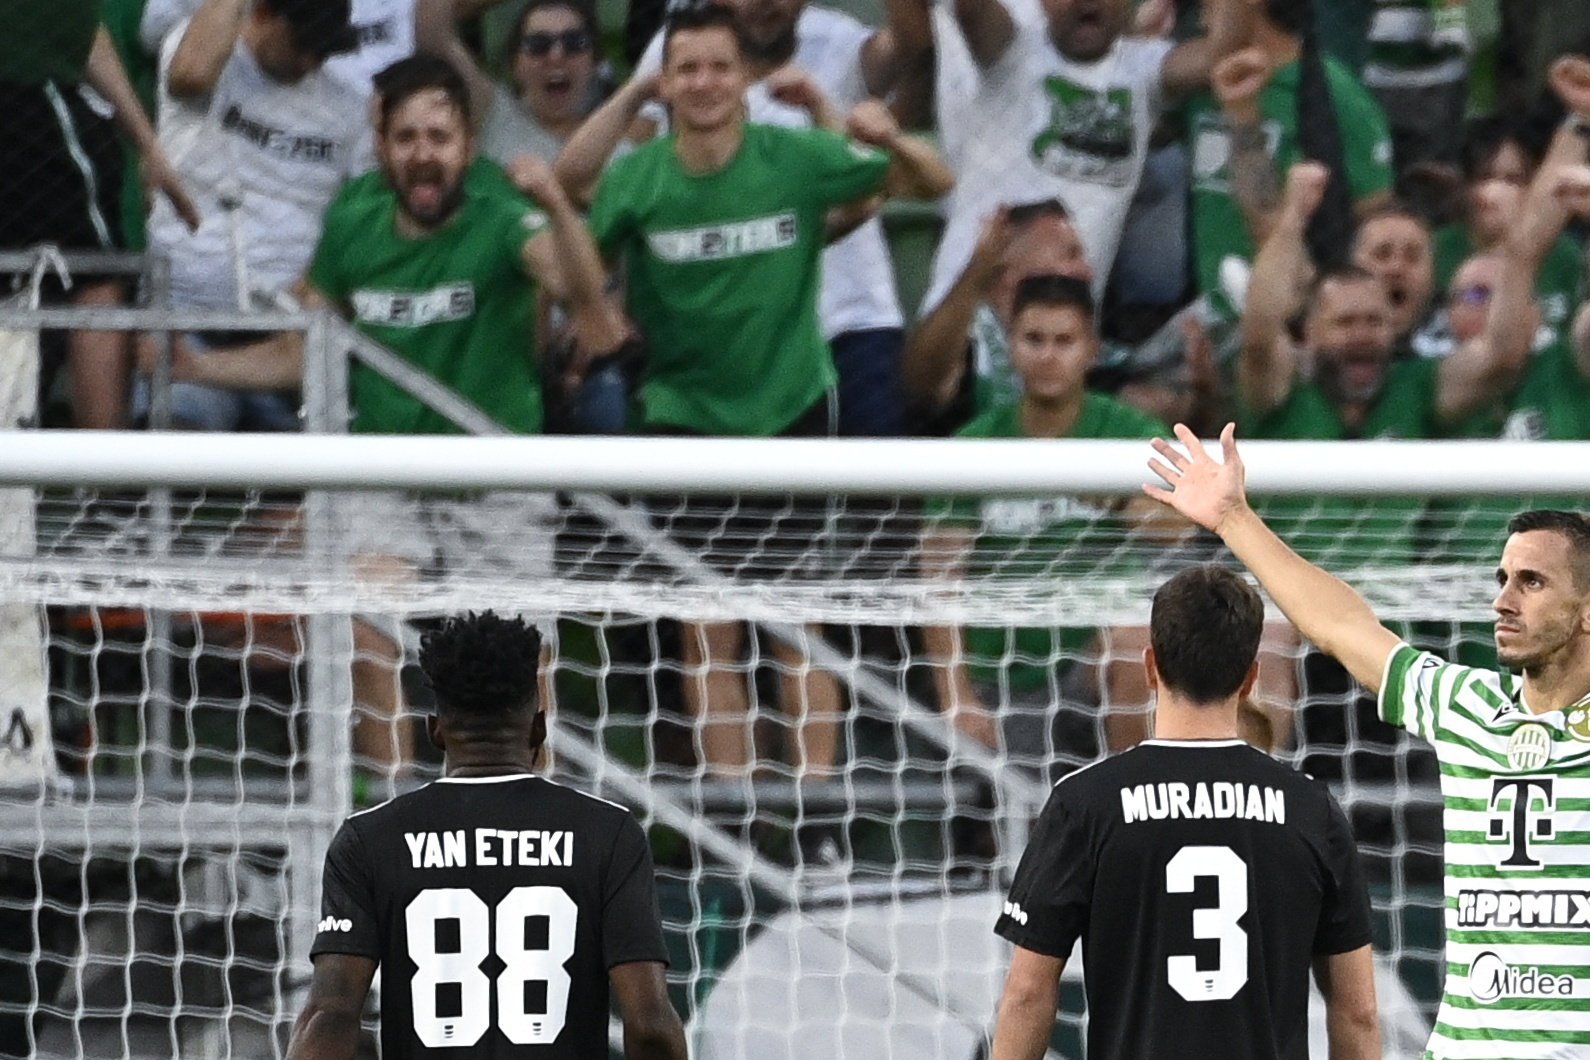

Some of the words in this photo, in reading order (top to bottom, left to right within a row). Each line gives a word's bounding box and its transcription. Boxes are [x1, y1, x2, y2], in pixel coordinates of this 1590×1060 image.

[1120, 782, 1285, 824] MURADIAN
[404, 830, 466, 868] YAN
[475, 828, 574, 867] ETEKI
[1166, 846, 1248, 1001] 3
[405, 886, 579, 1048] 88
[1478, 960, 1574, 998] Midea
